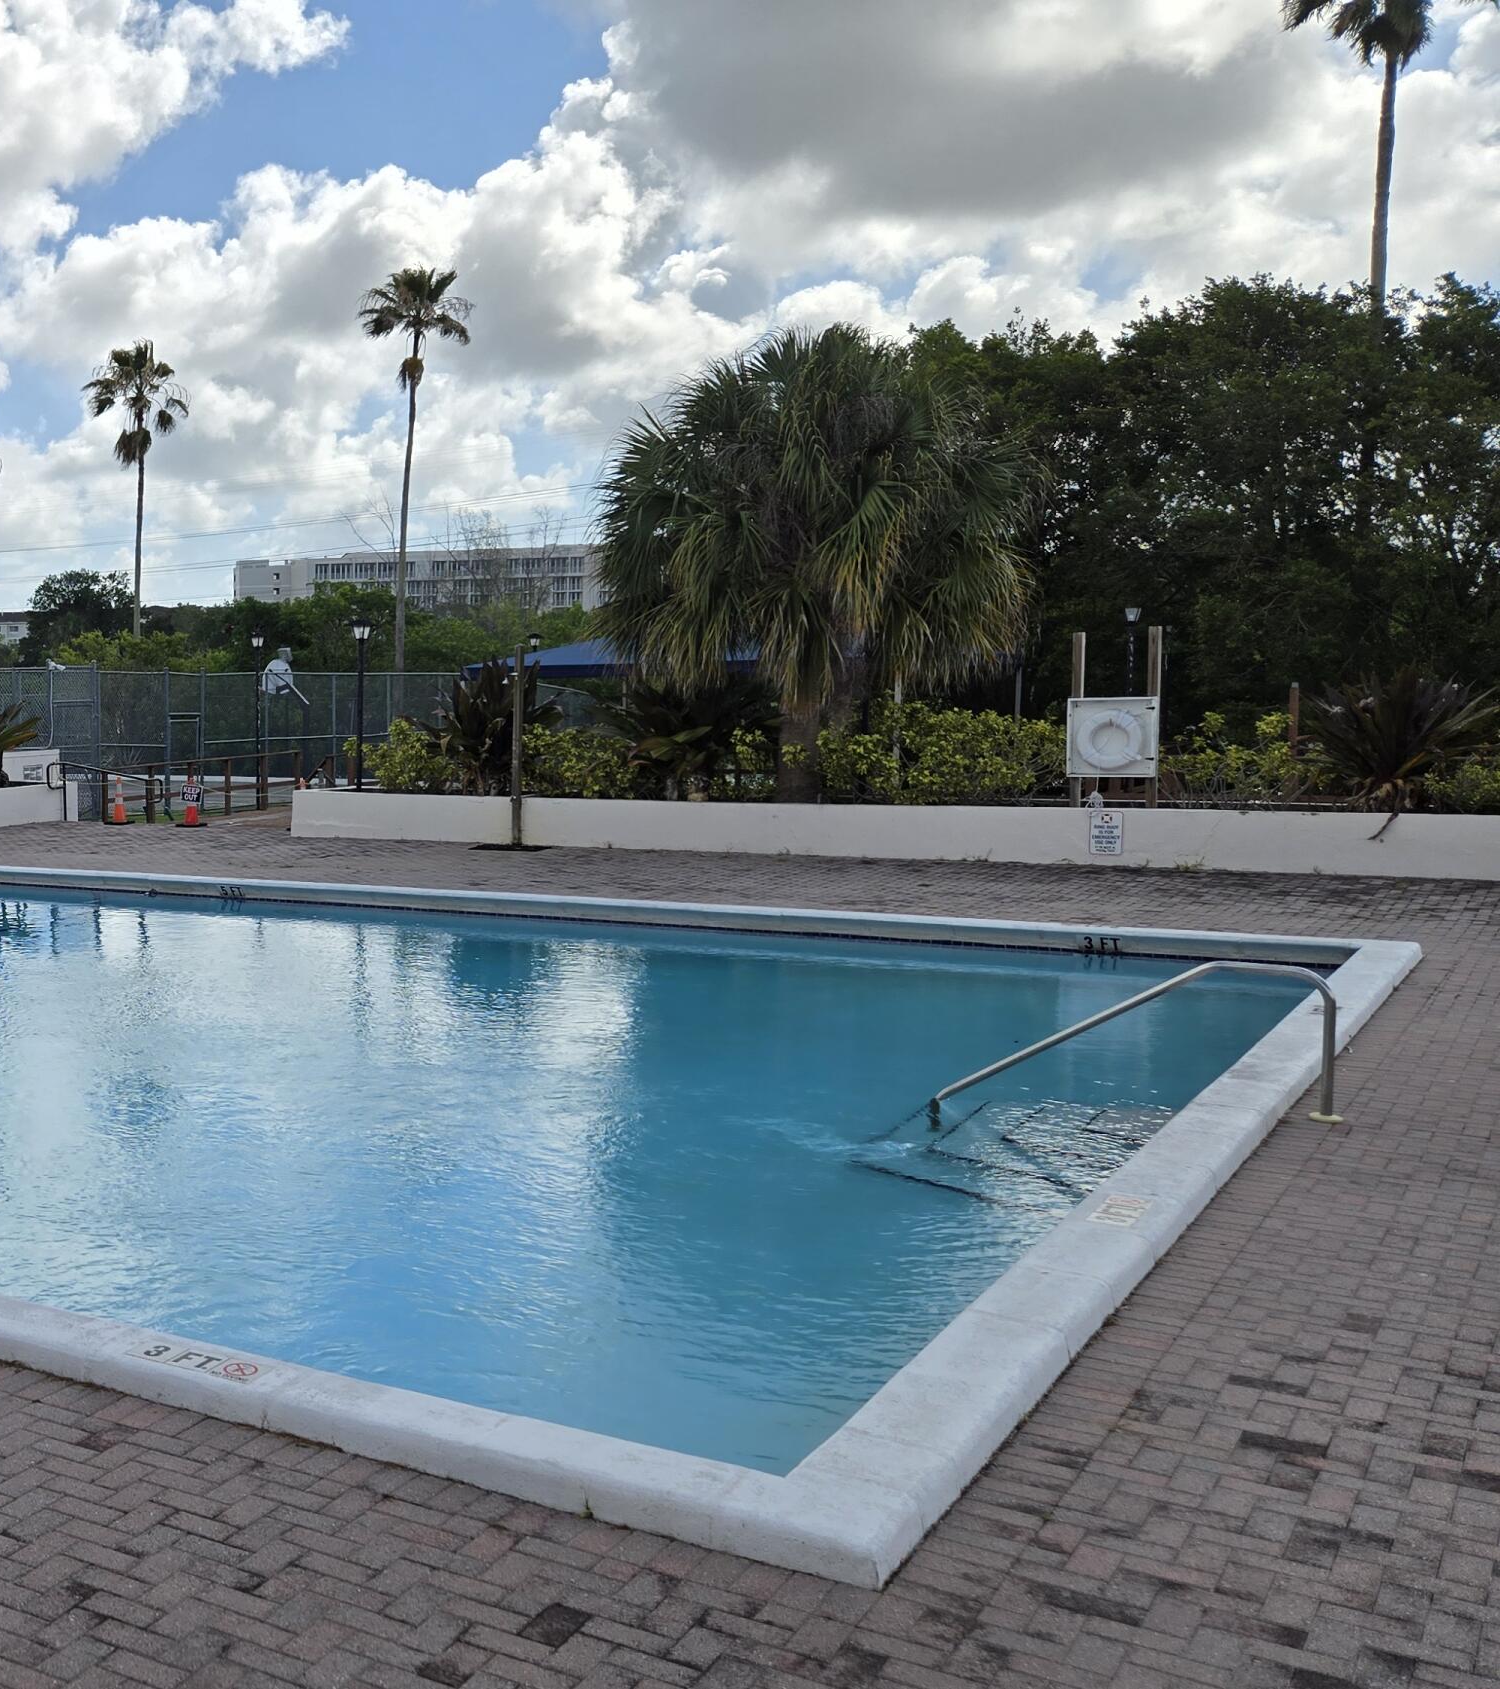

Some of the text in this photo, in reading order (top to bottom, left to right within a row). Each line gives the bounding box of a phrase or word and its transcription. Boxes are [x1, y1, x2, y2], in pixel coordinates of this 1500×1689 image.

[183, 786, 201, 795] KEEP
[184, 793, 198, 801] OUT
[220, 885, 243, 897] 5 FT
[1083, 936, 1121, 951] 3 FT
[143, 1345, 172, 1357] 3
